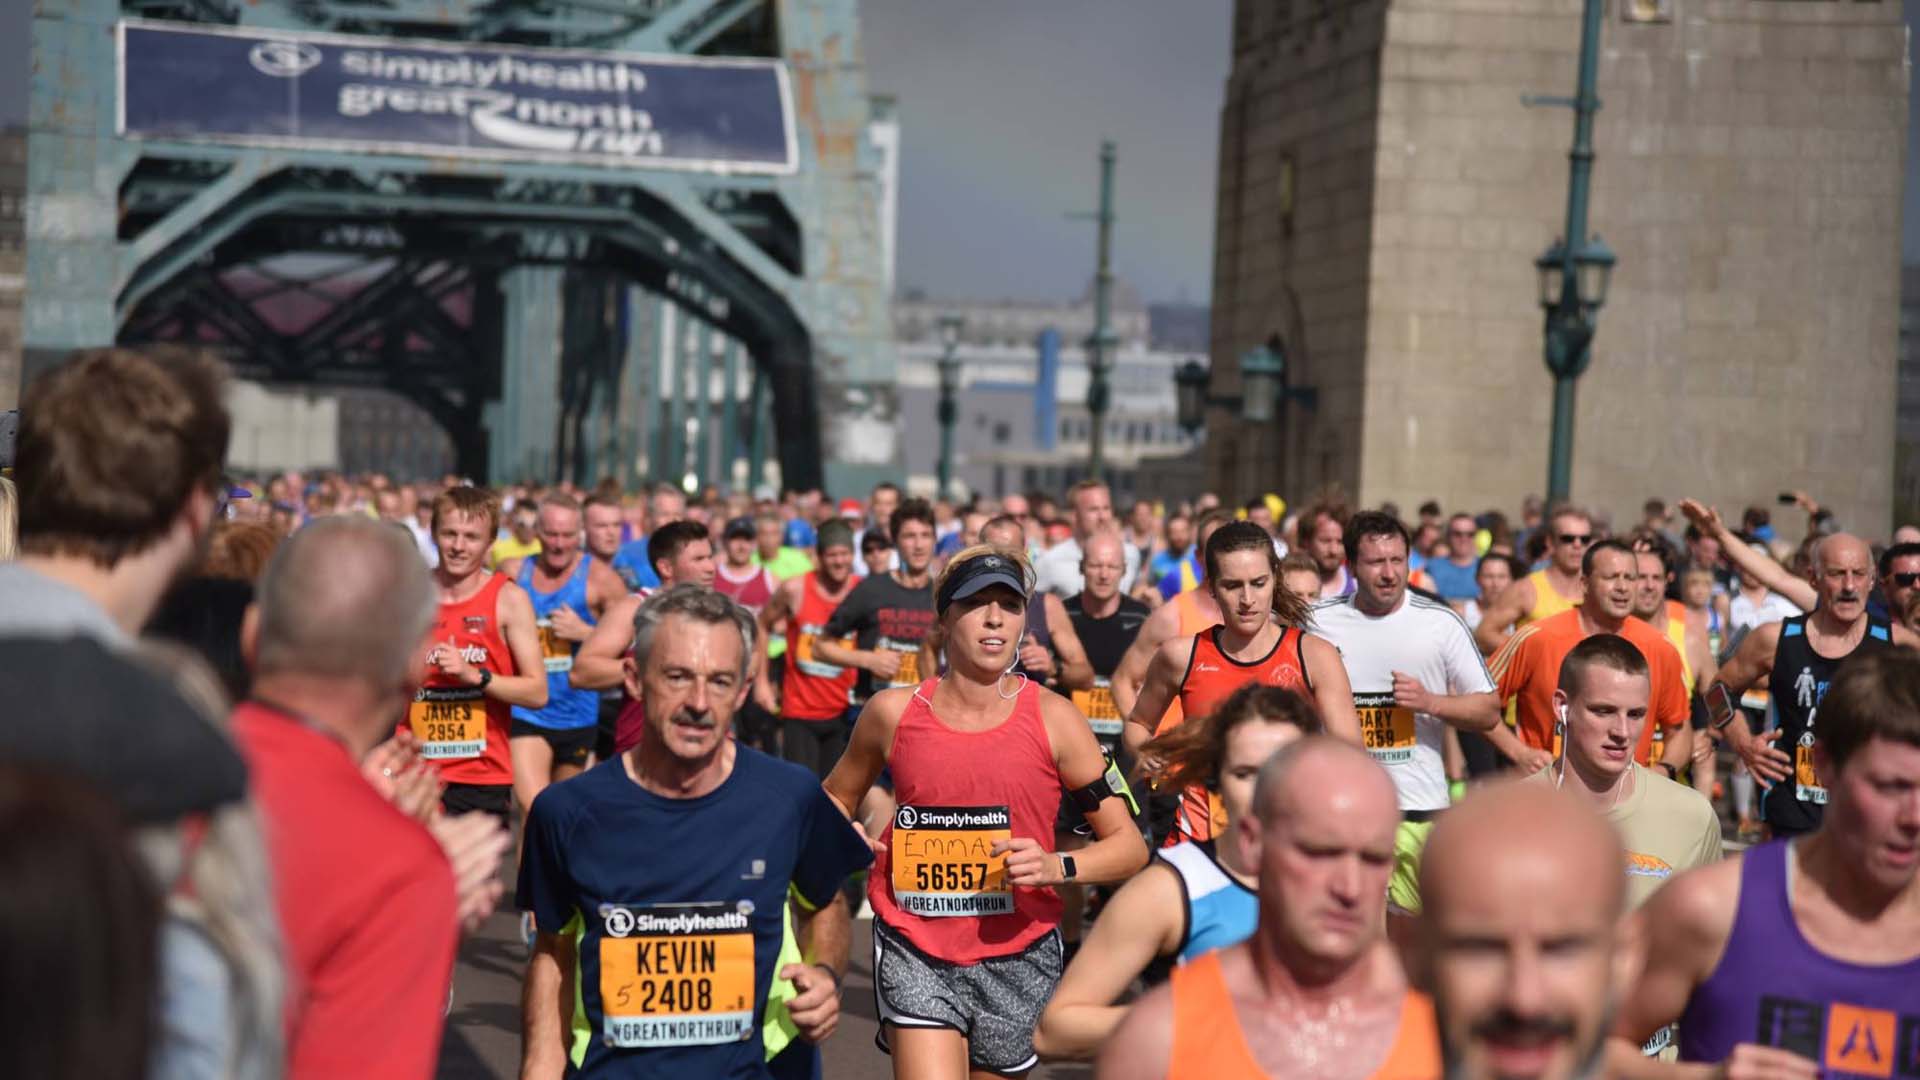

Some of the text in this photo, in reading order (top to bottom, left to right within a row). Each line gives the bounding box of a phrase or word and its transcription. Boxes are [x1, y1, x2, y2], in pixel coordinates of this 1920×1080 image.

[422, 702, 473, 722] JAMES
[427, 723, 466, 741] 2954
[1366, 729, 1395, 748] 358
[920, 811, 1008, 828] Simplyhealth
[916, 863, 988, 891] 56557
[904, 896, 1007, 912] #GREATNORTHRUN
[637, 911, 748, 934] Simplyhealth
[636, 940, 715, 975] KEVIN
[641, 978, 712, 1013] 2408
